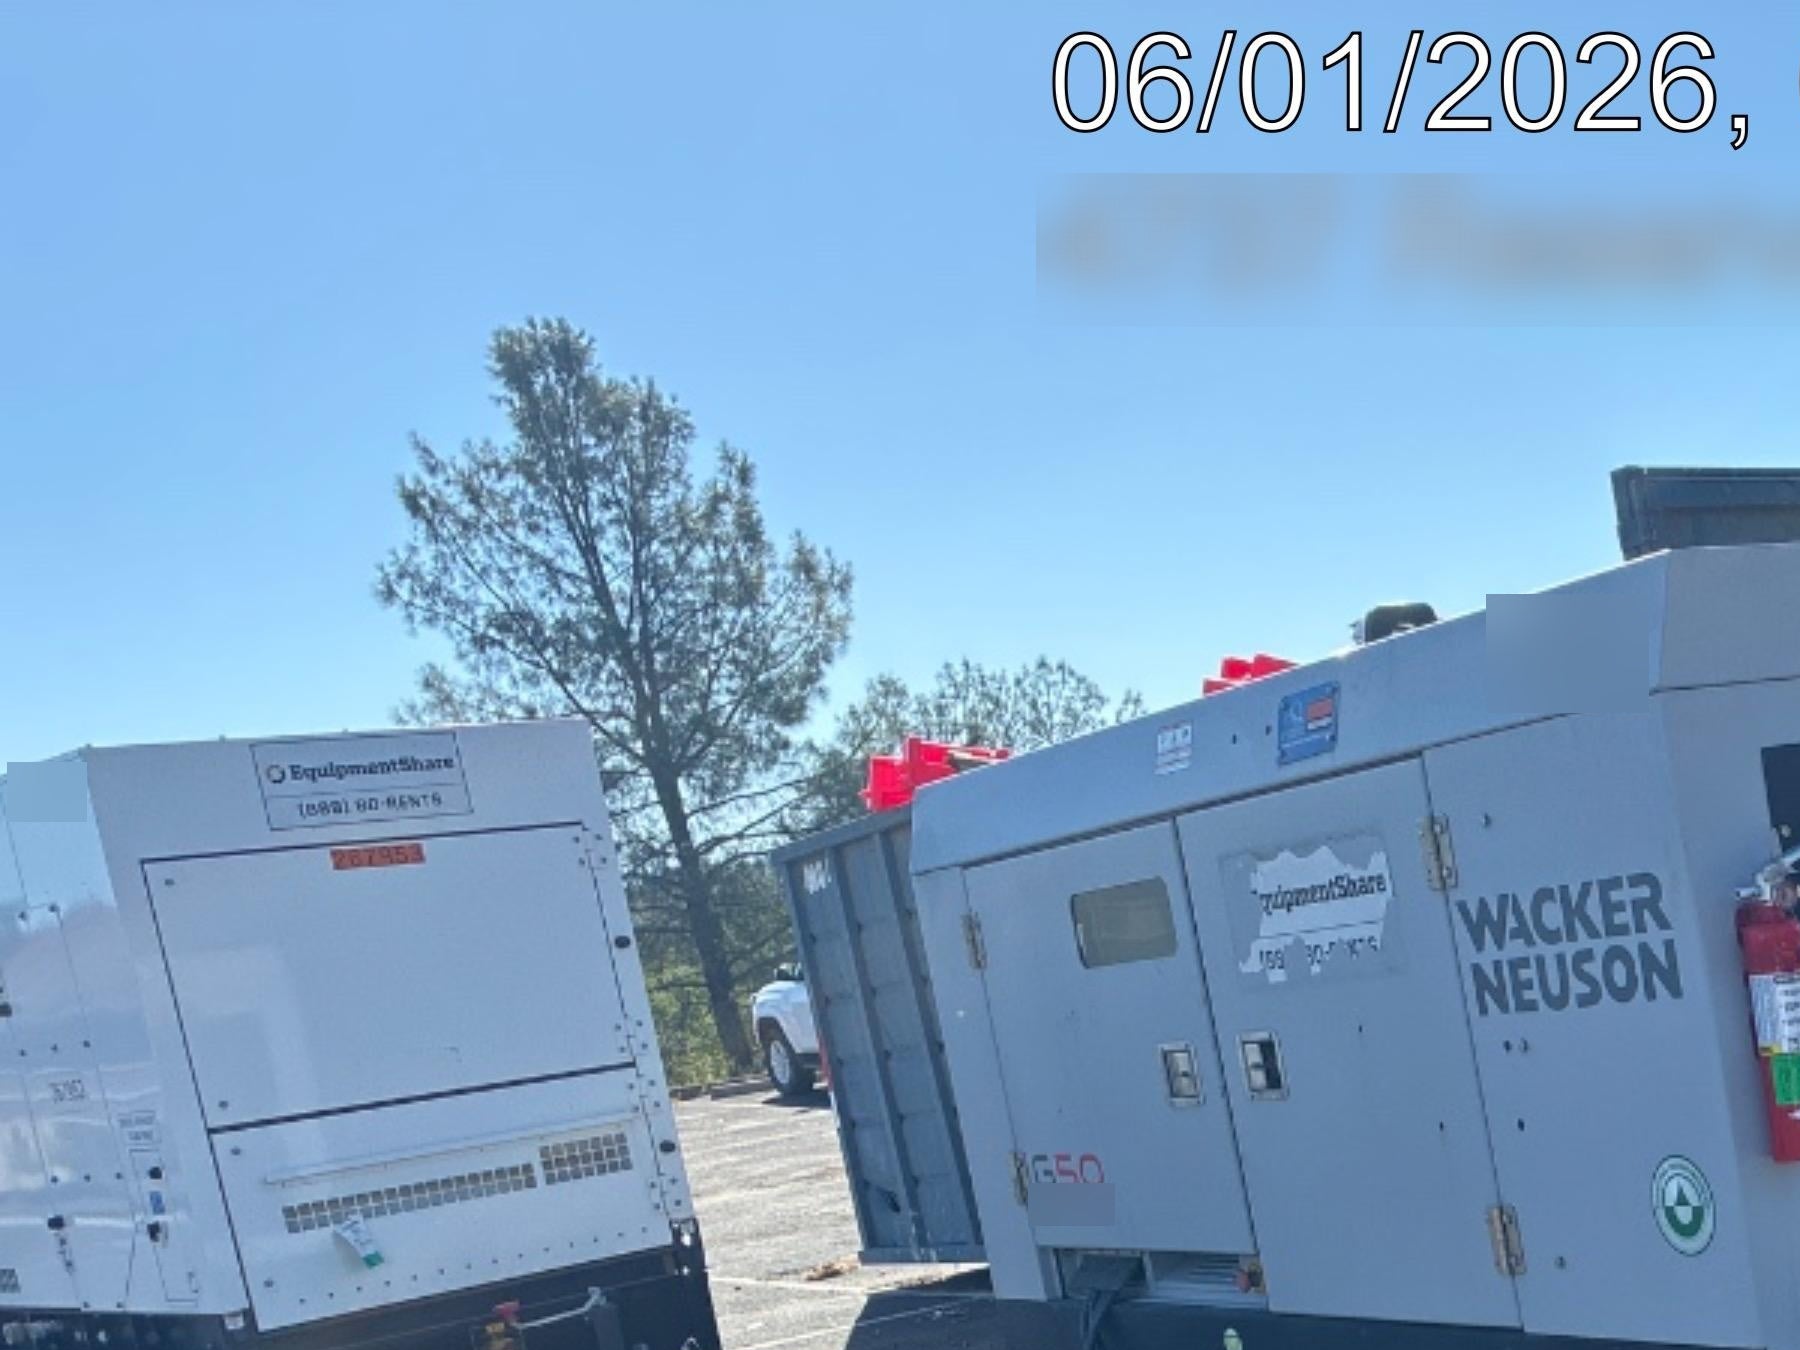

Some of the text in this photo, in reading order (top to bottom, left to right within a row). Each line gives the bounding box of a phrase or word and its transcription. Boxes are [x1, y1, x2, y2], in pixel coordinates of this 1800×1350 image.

[289, 755, 455, 784] EquipmentShare
[1250, 872, 1387, 916] quipmentShare
[1455, 872, 1673, 954] WACKER
[1470, 938, 1684, 1017] NEUSON
